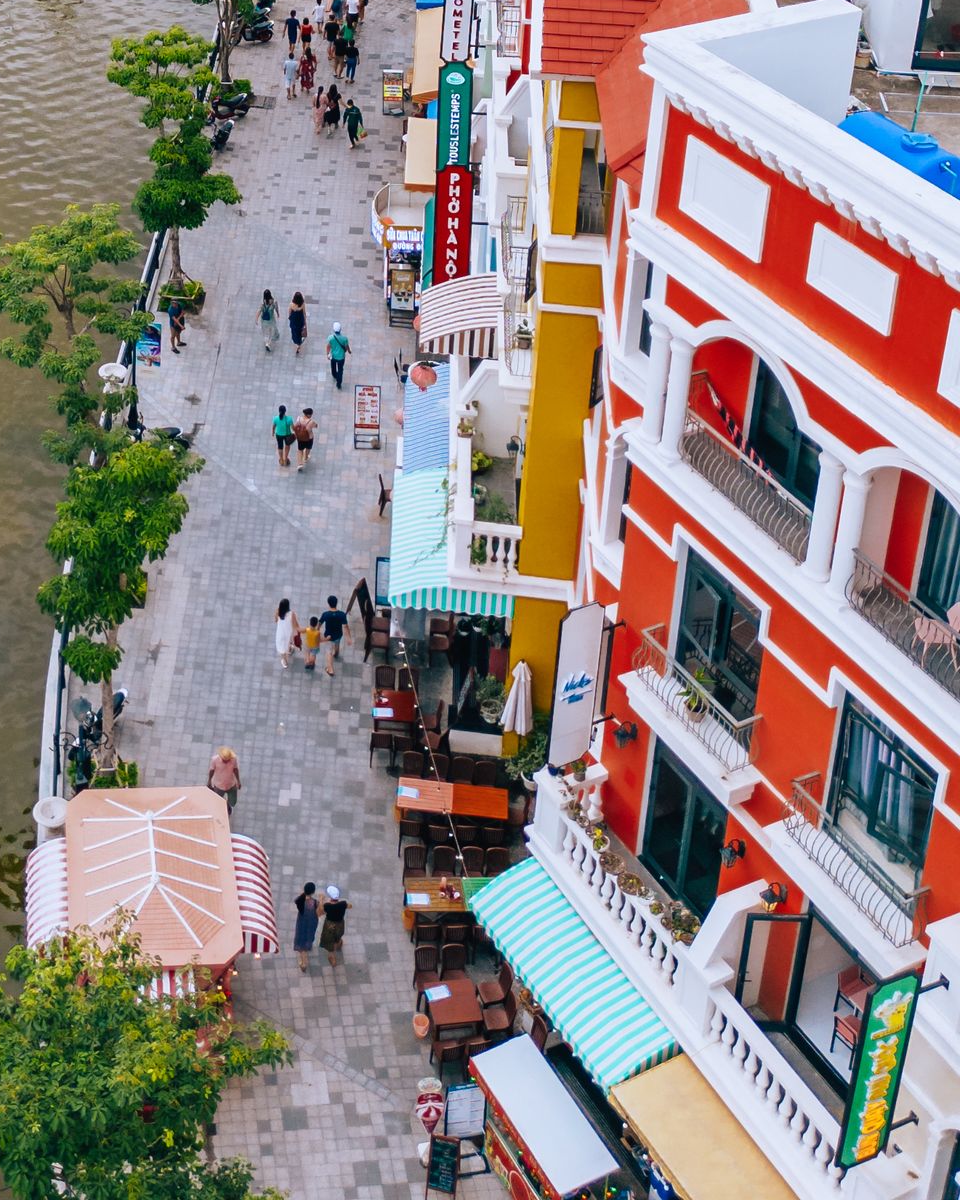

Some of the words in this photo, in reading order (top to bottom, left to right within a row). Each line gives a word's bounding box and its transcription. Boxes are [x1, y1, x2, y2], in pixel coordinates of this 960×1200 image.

[448, 172, 460, 214] PHỞ
[446, 217, 459, 245] HÀ
[445, 248, 458, 281] NỘ
